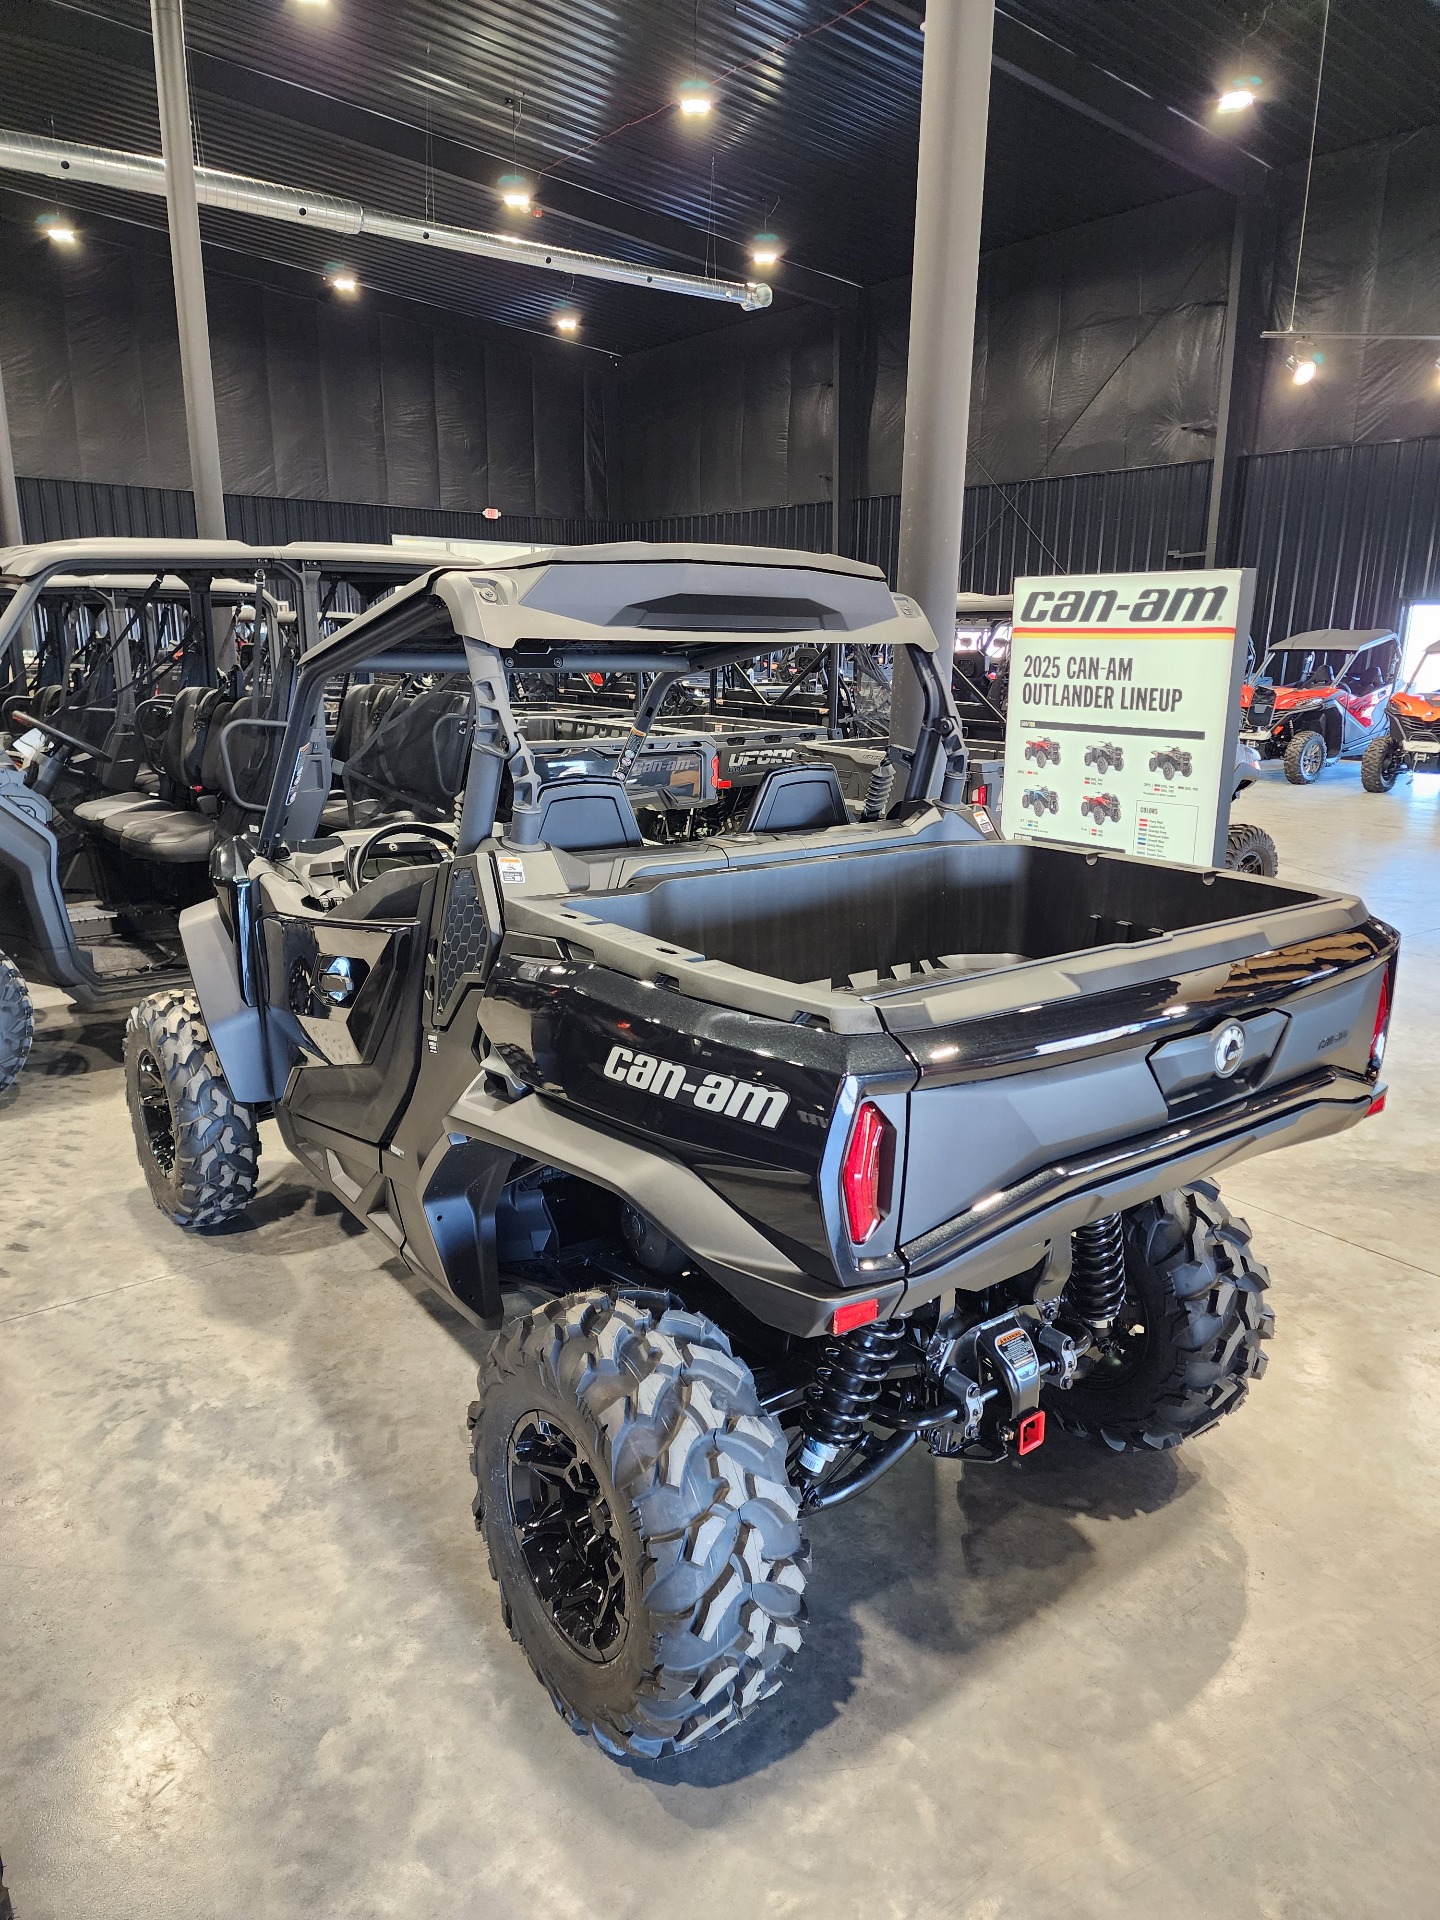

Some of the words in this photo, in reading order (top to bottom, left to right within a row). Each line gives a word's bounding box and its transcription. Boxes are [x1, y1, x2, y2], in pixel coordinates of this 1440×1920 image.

[1020, 585, 1229, 623] can-am
[1023, 654, 1061, 679] 2025
[1066, 656, 1133, 681] CAN-AM
[1022, 682, 1115, 710] OUTLANDER
[1120, 686, 1183, 713] LINEUP
[603, 1045, 790, 1130] can-am
